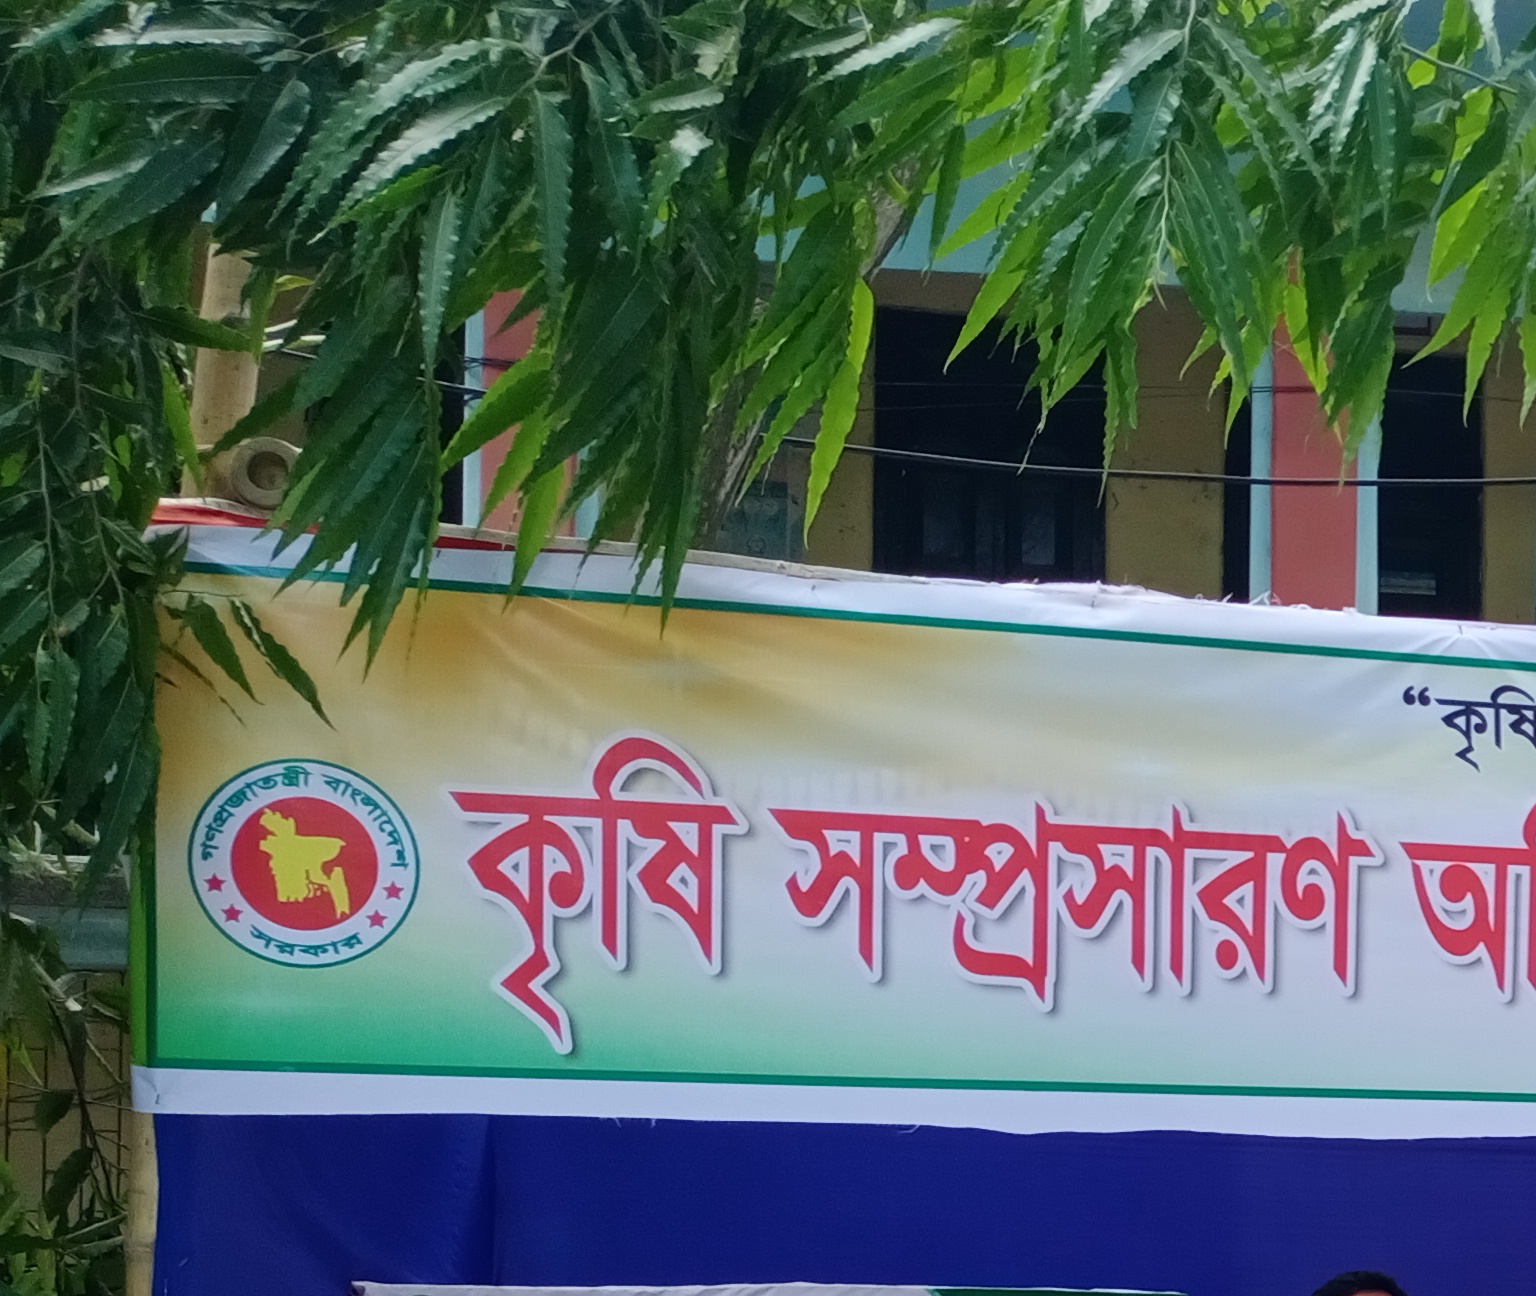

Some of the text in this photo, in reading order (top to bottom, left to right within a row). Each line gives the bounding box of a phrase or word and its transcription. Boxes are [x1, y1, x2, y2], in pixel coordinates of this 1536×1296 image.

[201, 765, 409, 871] গণপ্রজাতন্ত্রী বাংলাদেশ
[250, 924, 363, 957] সরকার
[448, 733, 749, 1054] কৃষি
[770, 802, 1383, 1009] সম্প্রসারণ
